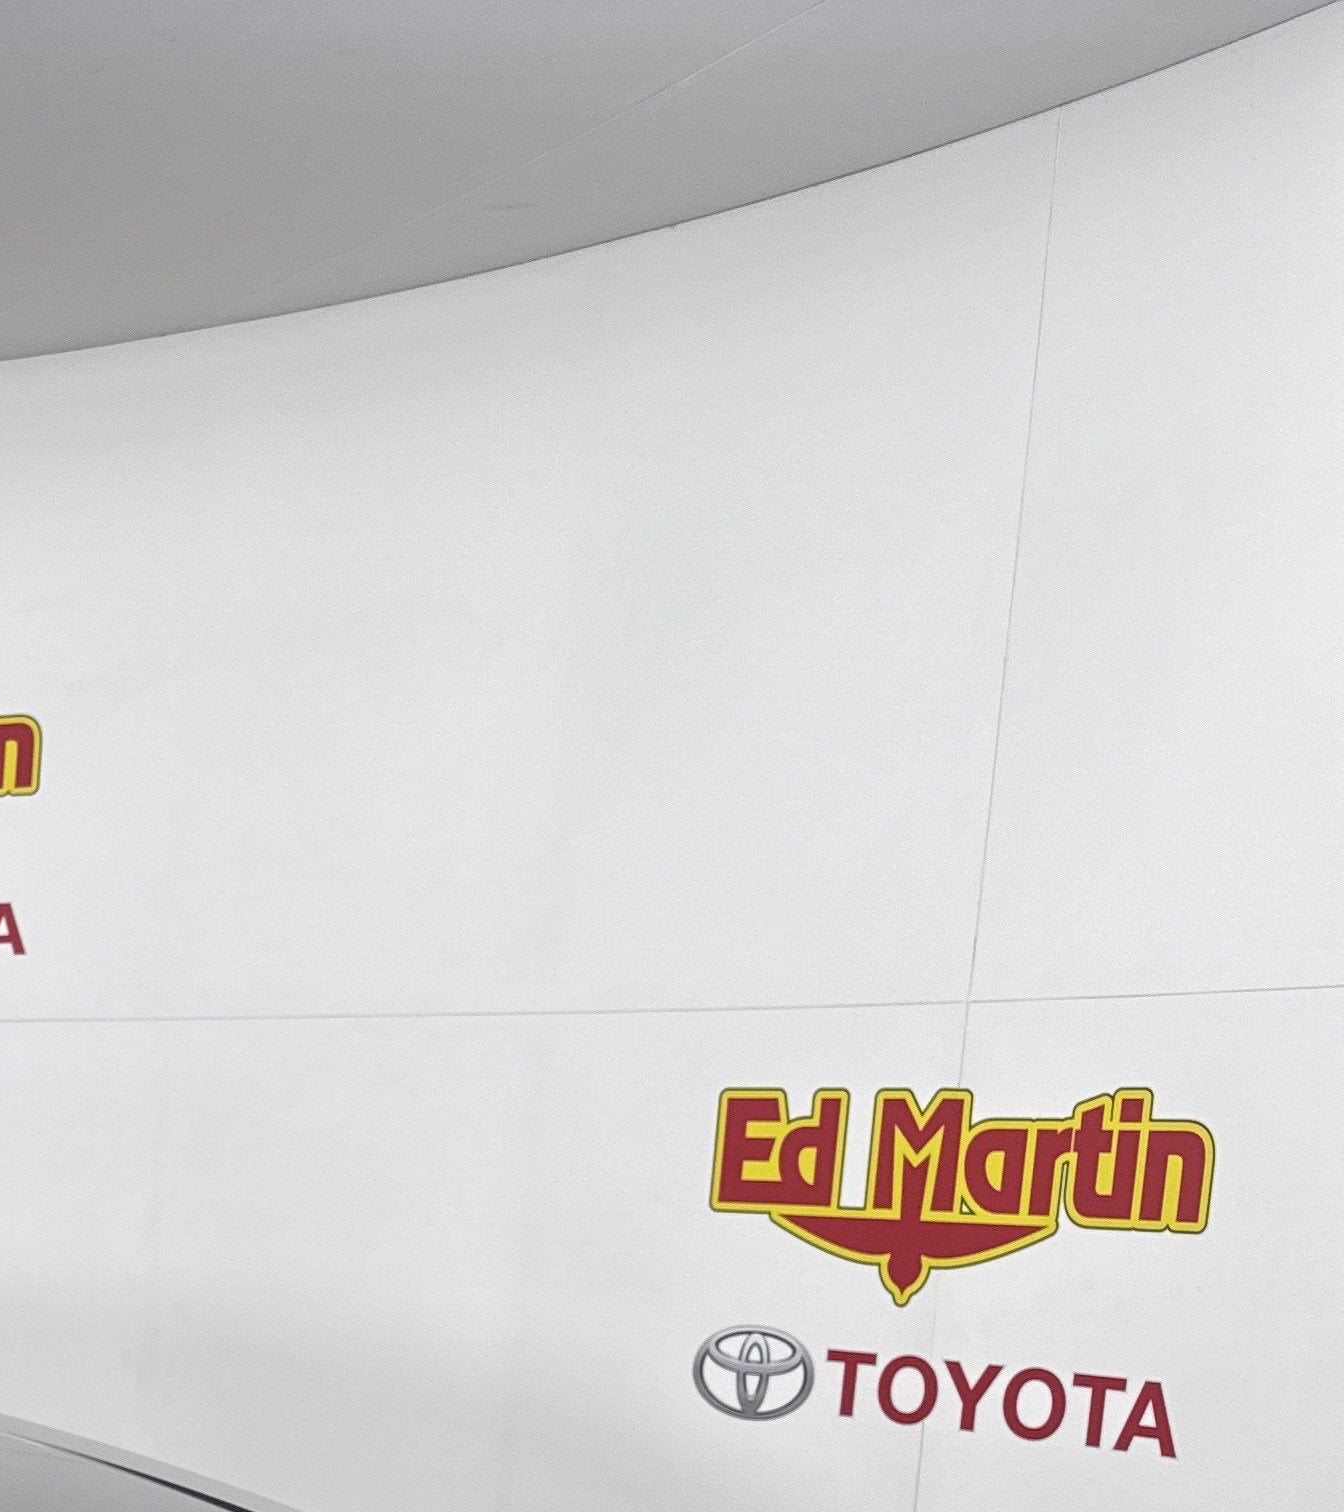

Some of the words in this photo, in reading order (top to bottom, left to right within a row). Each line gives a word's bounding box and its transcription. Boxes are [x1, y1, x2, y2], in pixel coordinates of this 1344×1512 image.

[709, 1088, 849, 1212] Ed
[866, 1087, 1215, 1234] Martin
[827, 1348, 1178, 1460] TOYOTA
